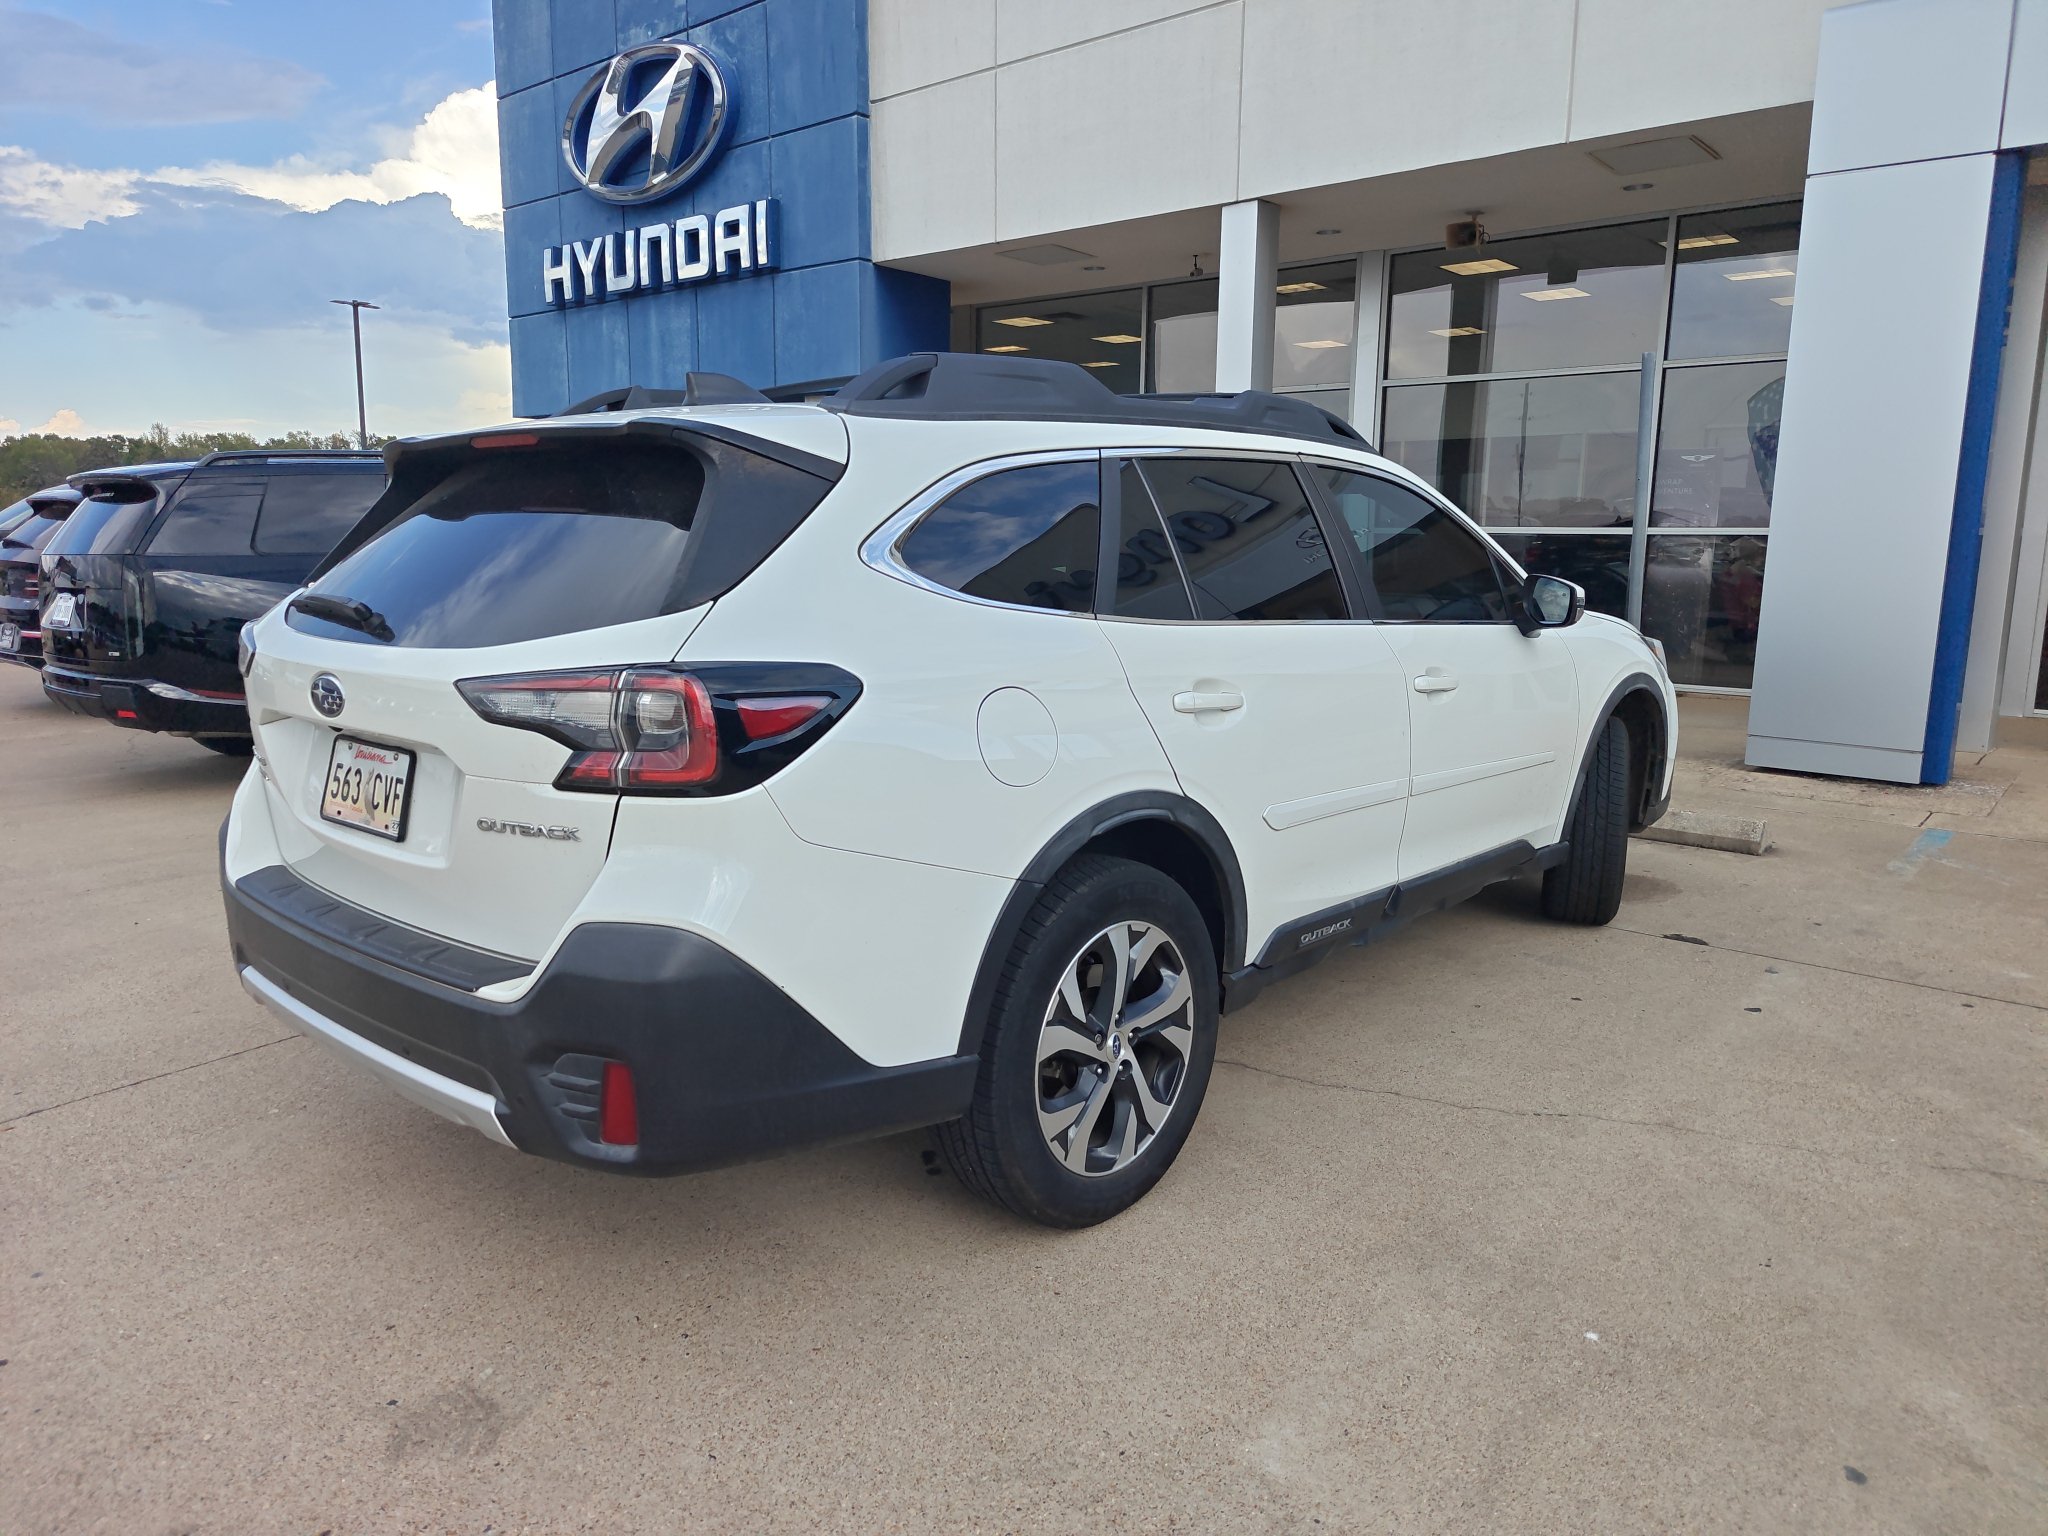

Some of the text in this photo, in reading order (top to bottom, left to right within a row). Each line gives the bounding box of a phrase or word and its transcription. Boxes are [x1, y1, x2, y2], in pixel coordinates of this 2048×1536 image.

[543, 199, 770, 304] HYUNDAI
[354, 745, 393, 765] Louisiana
[330, 762, 404, 816] 563 CVF
[477, 816, 582, 842] OUTBACK
[1300, 918, 1352, 943] OUTBACK
